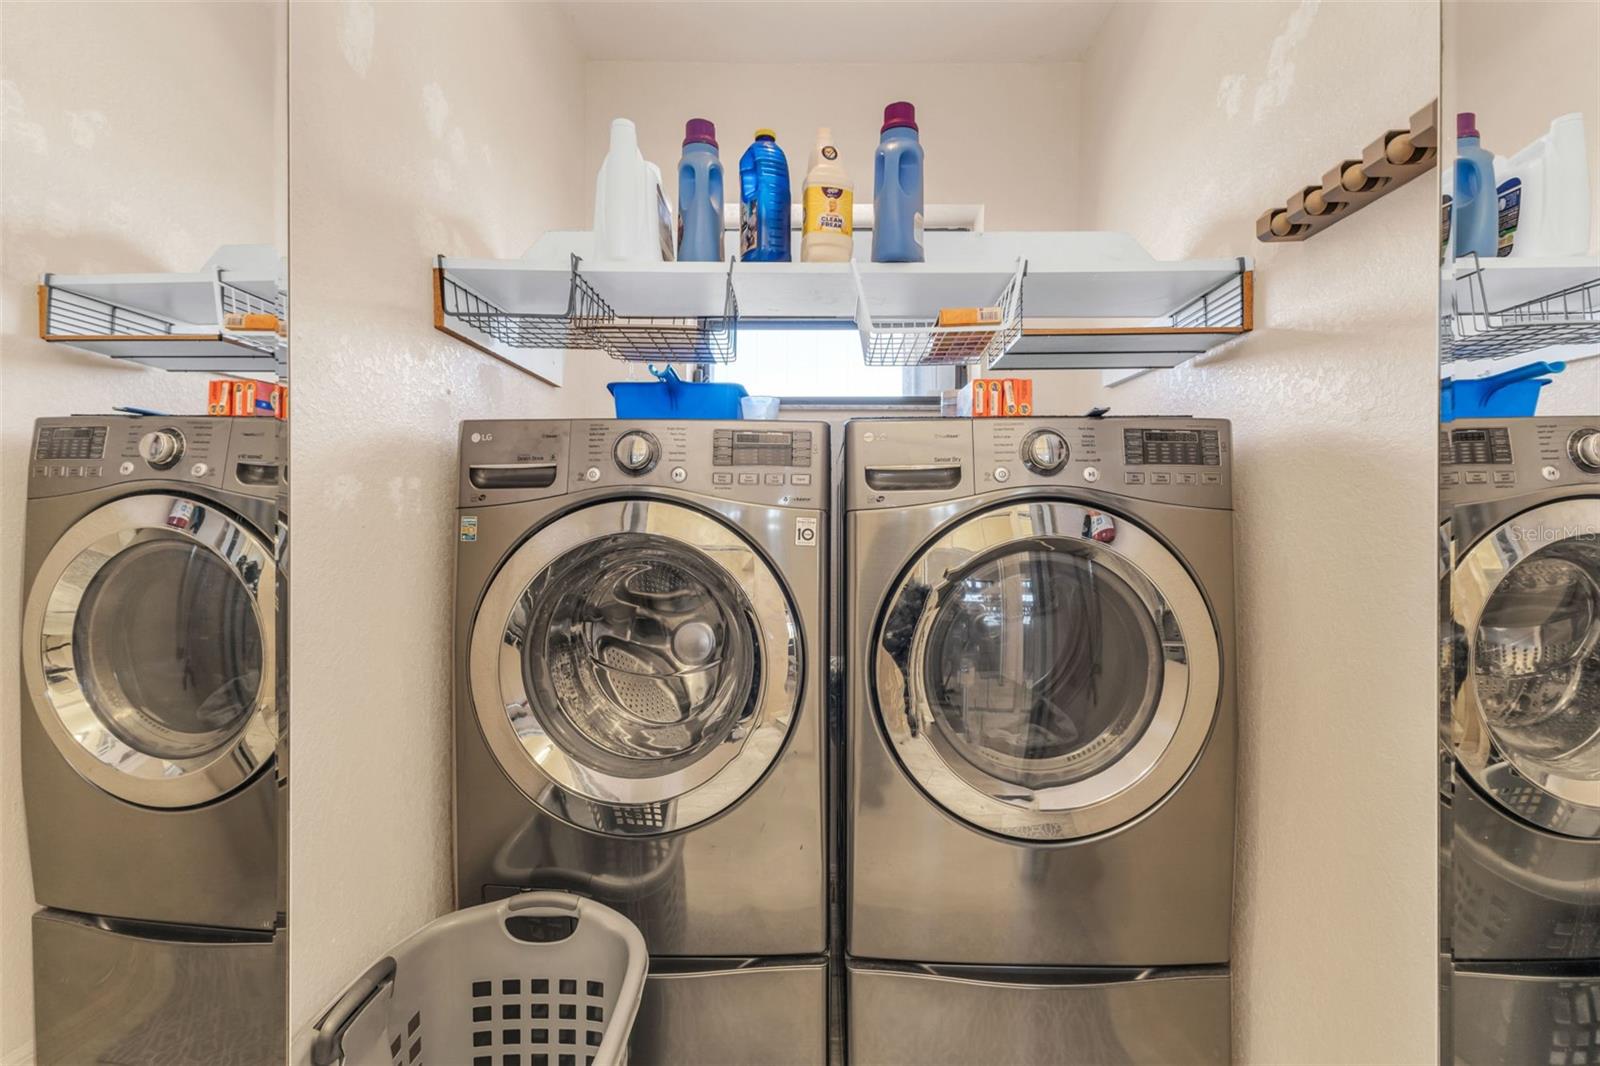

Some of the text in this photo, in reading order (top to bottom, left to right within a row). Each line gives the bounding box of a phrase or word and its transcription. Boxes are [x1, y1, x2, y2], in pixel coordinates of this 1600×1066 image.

[821, 216, 843, 224] CLEAN
[481, 433, 493, 441] LG
[798, 527, 815, 541] 10
